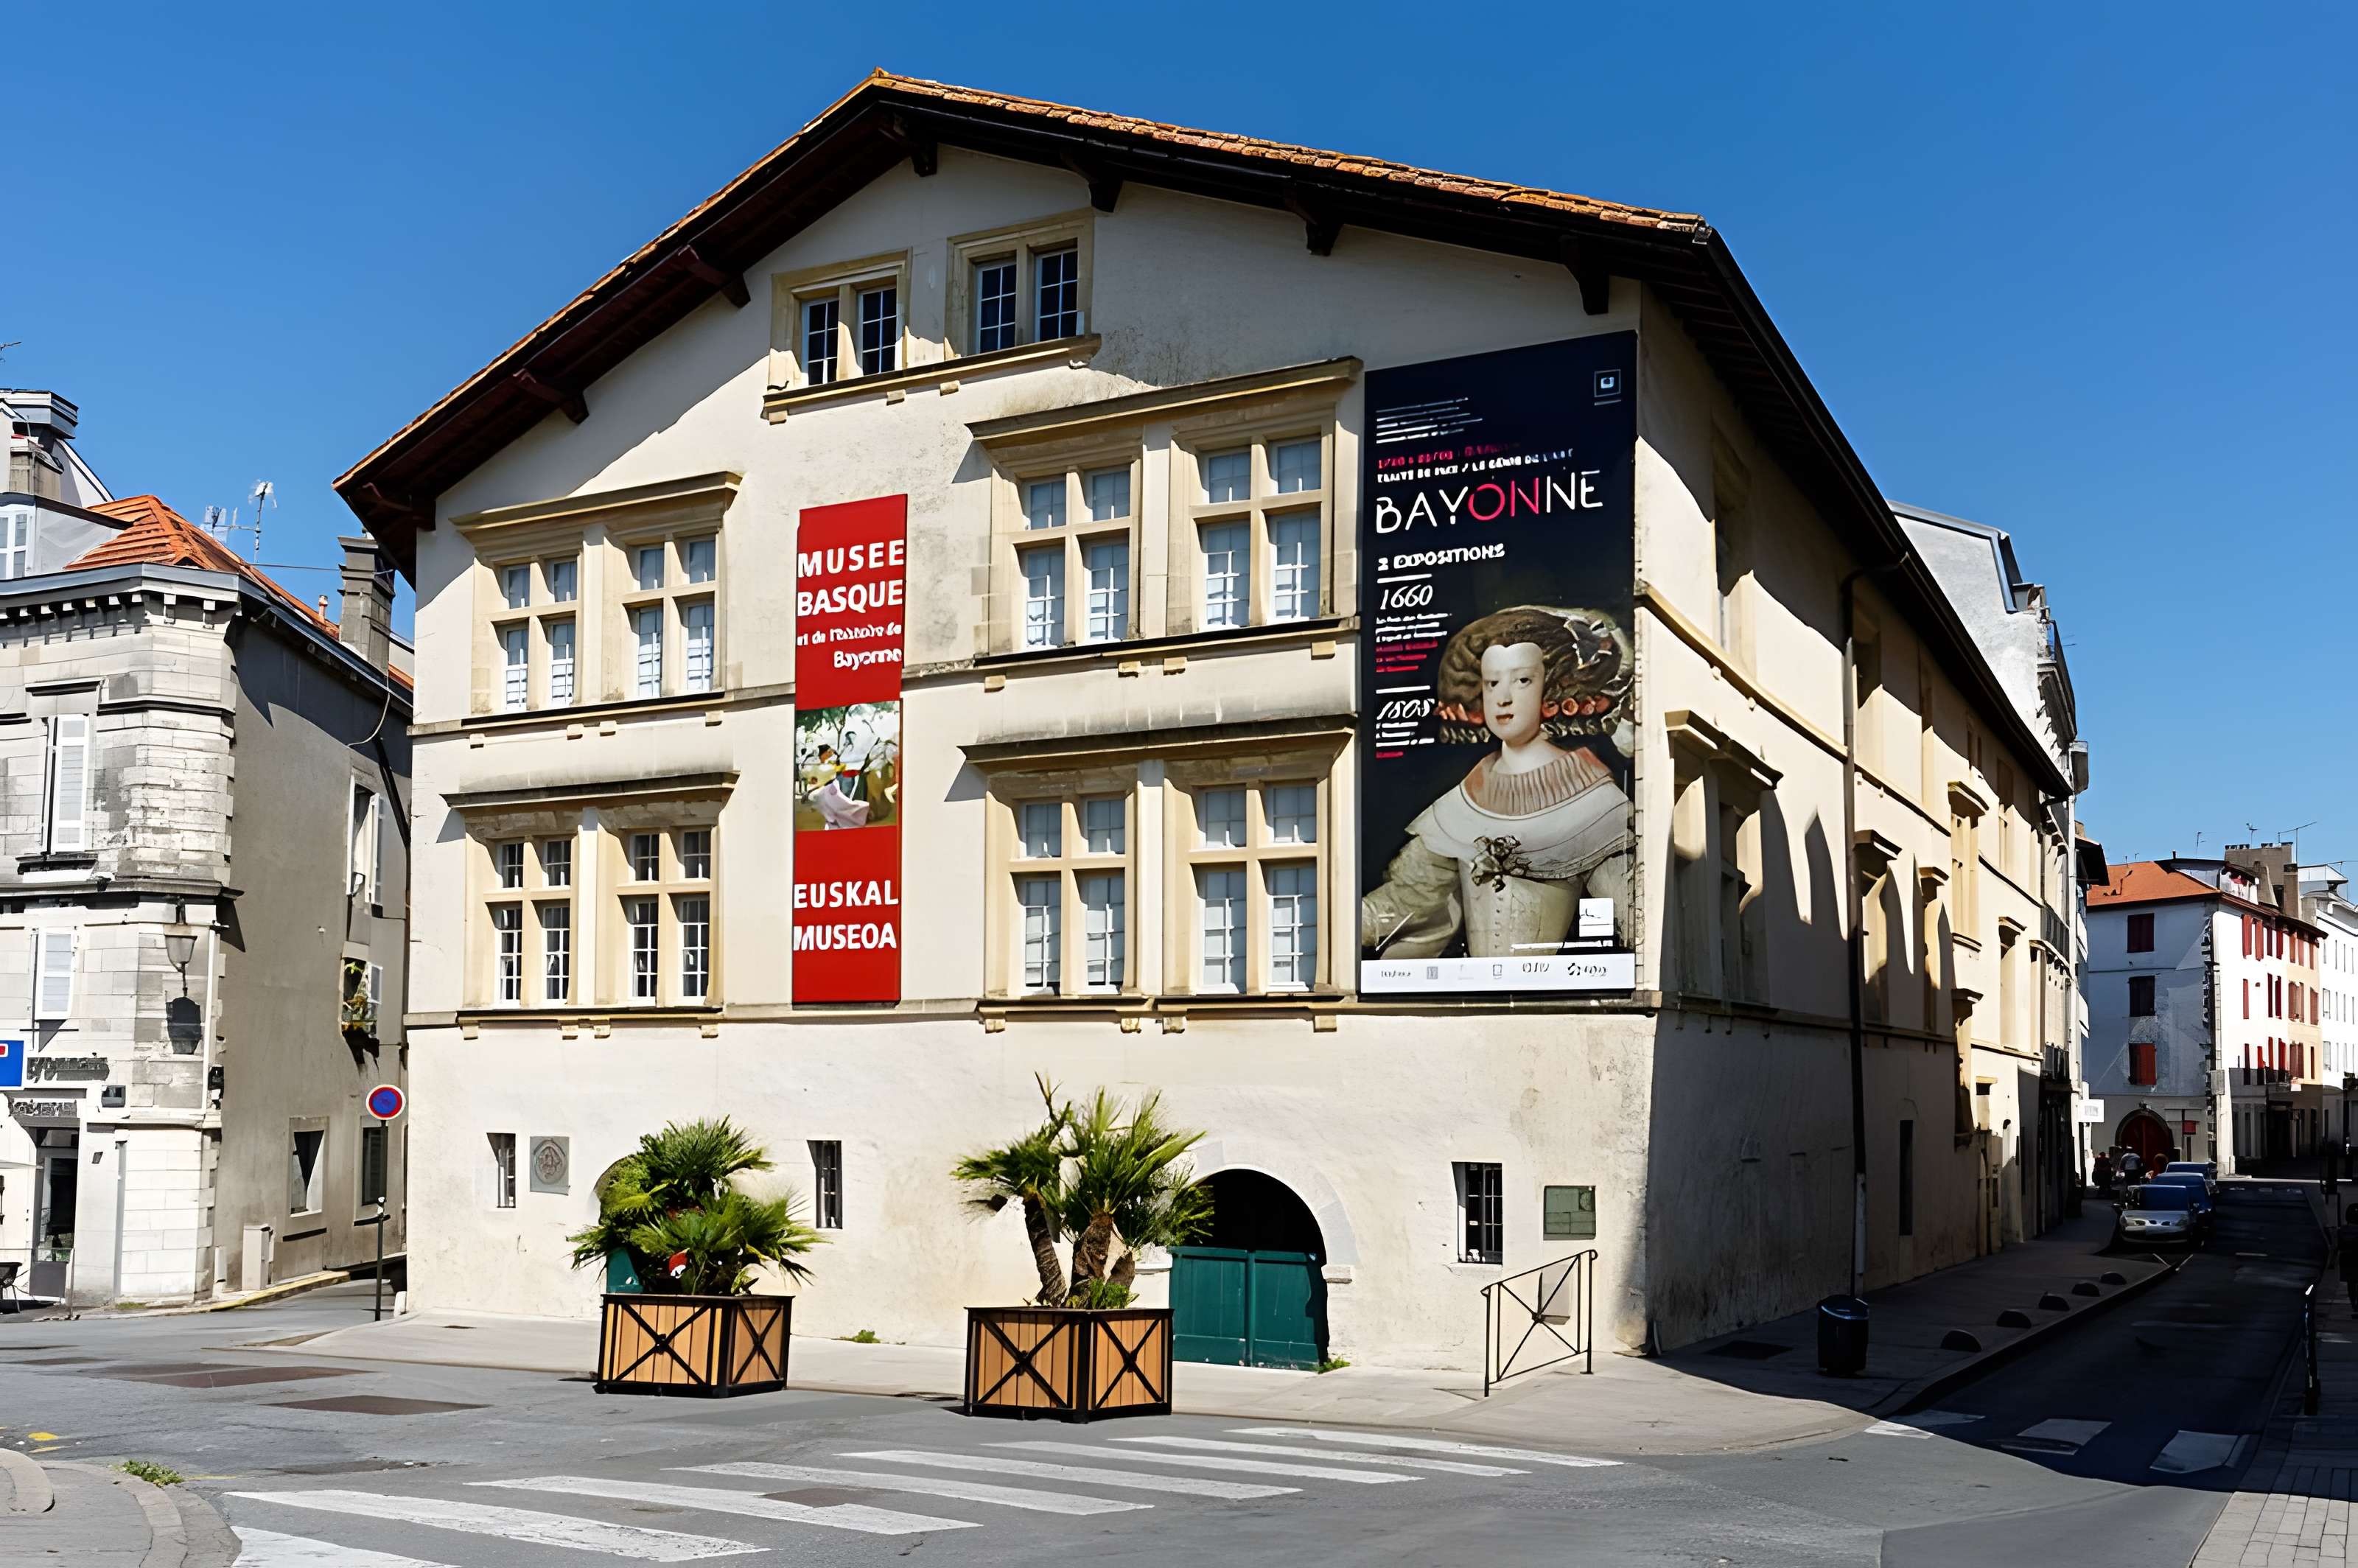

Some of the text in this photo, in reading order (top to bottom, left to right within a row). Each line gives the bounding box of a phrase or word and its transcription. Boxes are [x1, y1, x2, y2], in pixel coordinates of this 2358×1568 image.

[1376, 469, 1603, 534] BAYONNE
[797, 539, 905, 578] MUSEE
[797, 579, 903, 617] BASQUE
[1379, 584, 1433, 610] 1660
[794, 879, 900, 909] EUSKAL
[793, 922, 897, 951] MUSEOA
